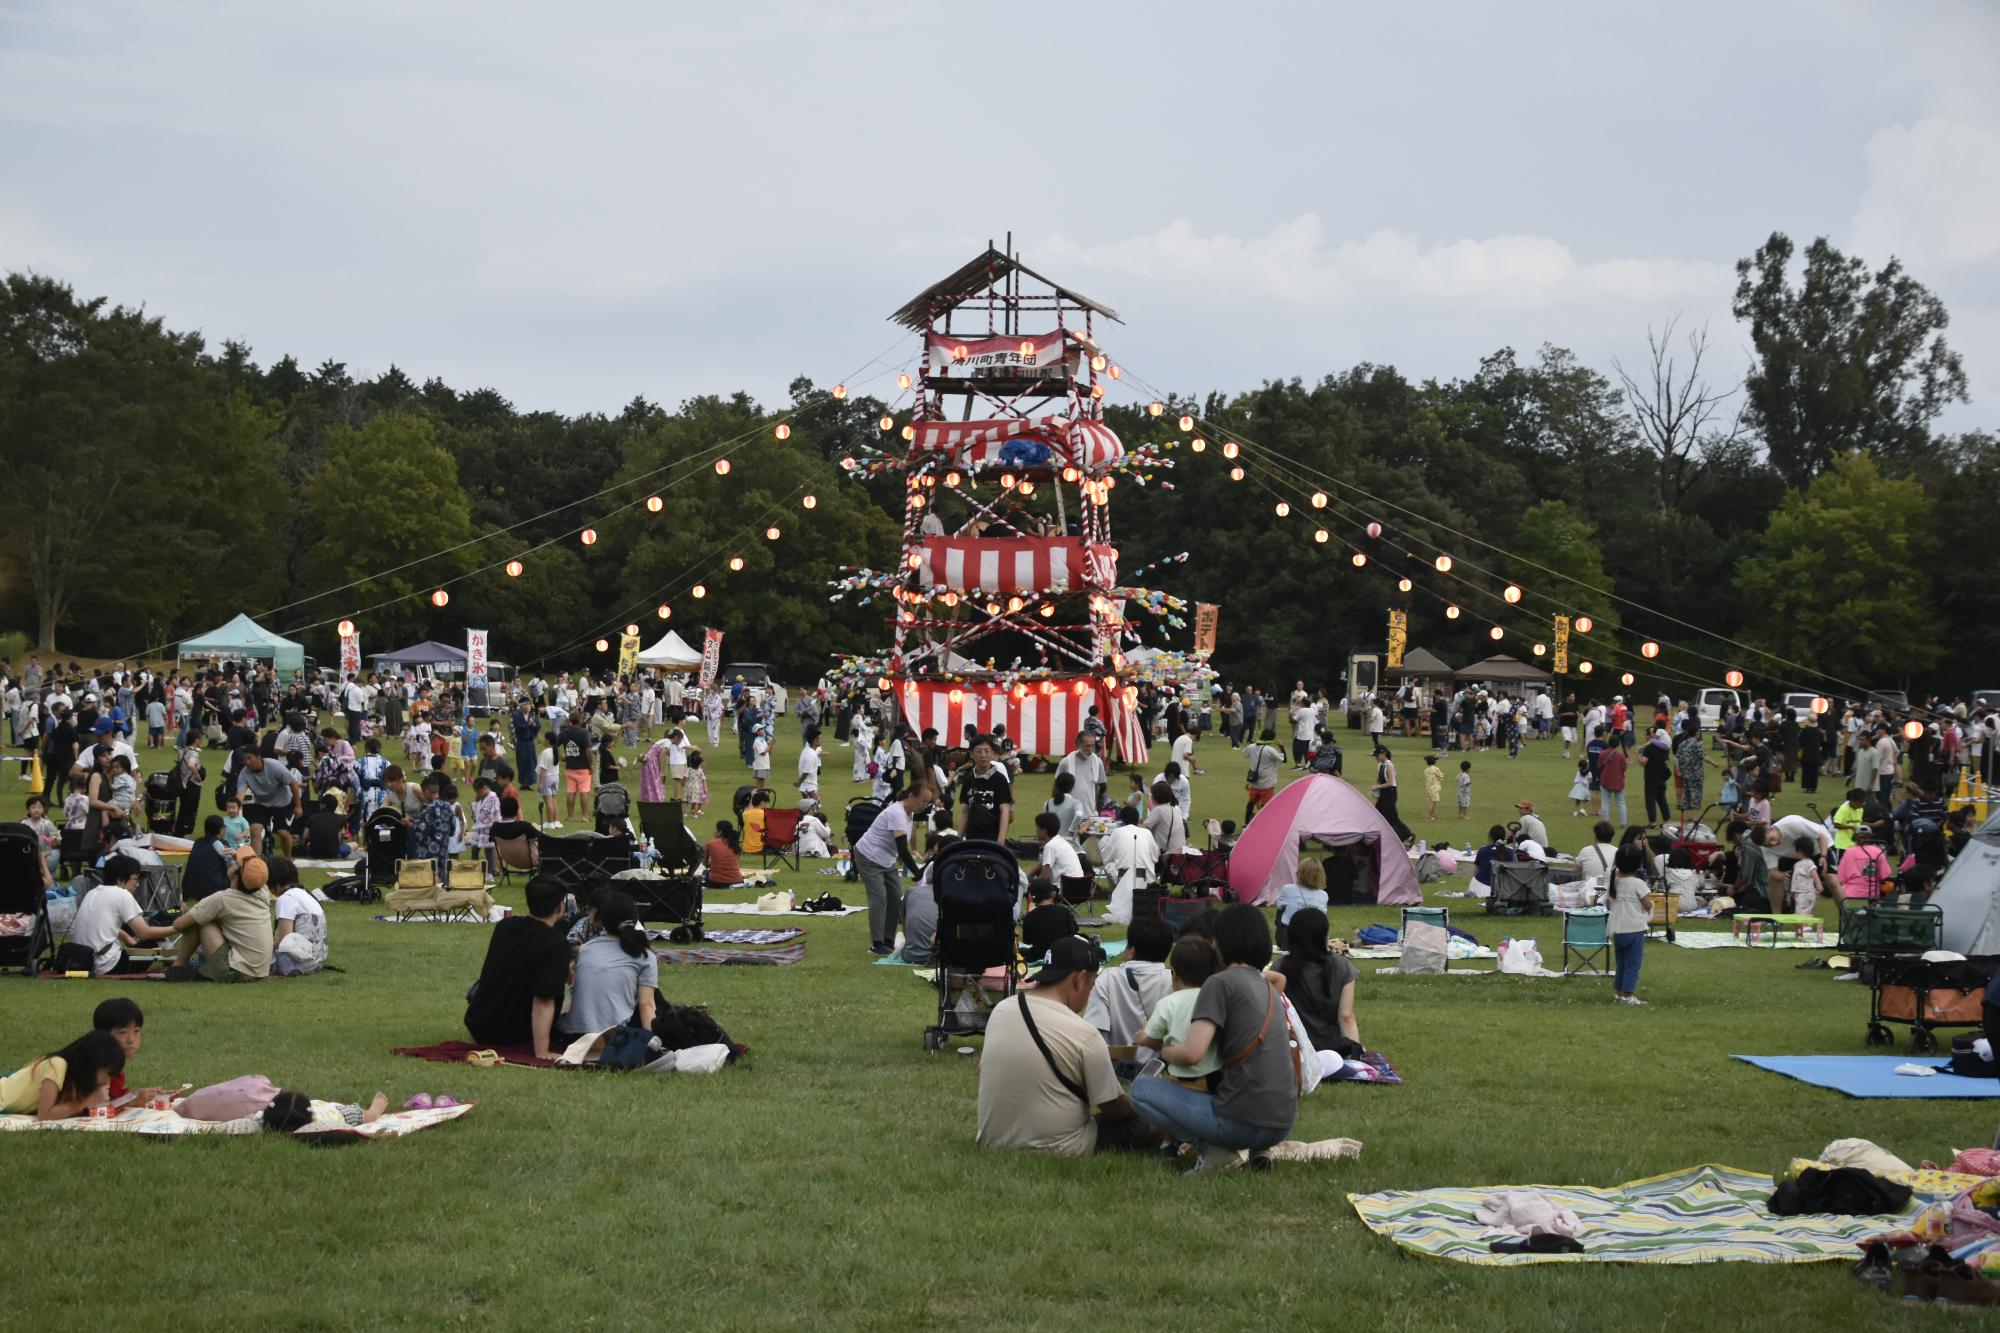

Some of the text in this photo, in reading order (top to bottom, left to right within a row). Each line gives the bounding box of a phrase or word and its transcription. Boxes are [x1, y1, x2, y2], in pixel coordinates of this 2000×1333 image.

[1200, 610, 1214, 650] ポテト
[343, 636, 359, 672] かき氷
[471, 633, 485, 674] かき氷
